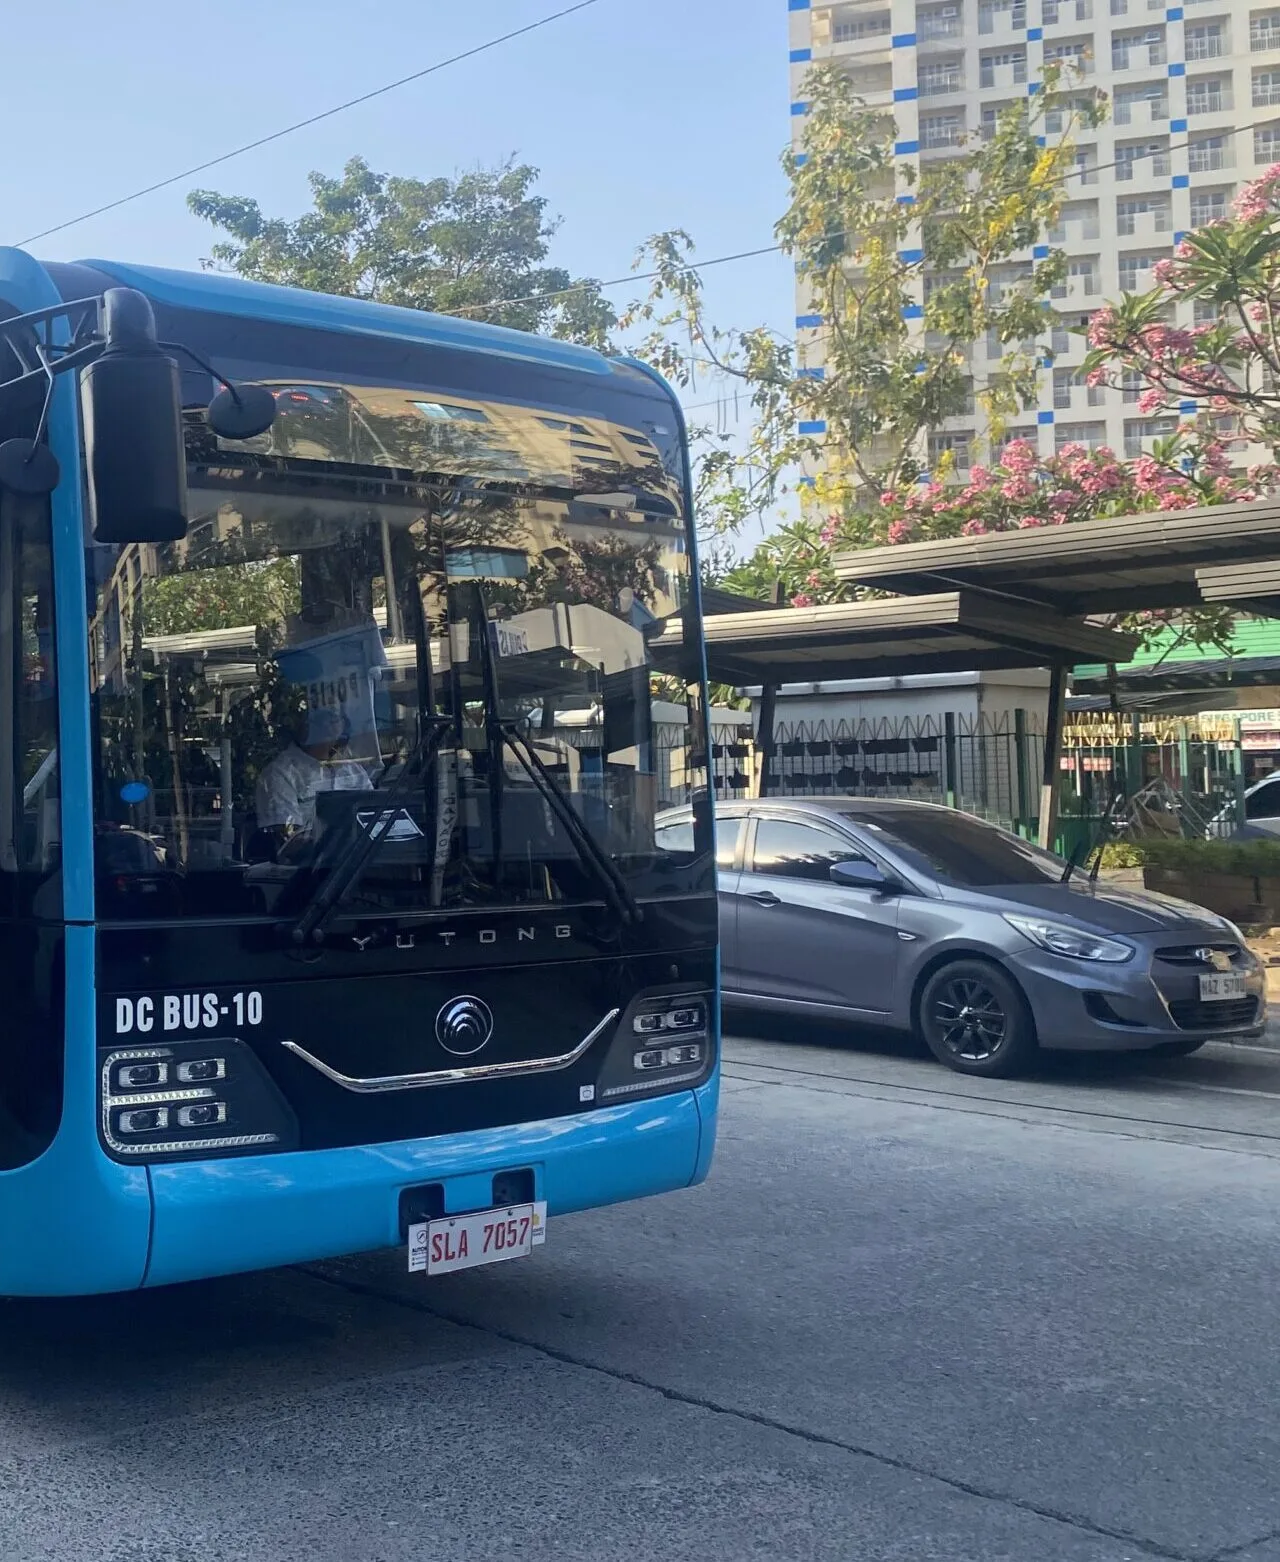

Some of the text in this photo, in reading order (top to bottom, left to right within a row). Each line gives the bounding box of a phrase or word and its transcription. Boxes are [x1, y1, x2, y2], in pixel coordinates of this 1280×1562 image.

[352, 924, 571, 950] YUTONG
[116, 991, 263, 1033] DC BUS-10
[431, 1229, 468, 1263] SLA
[482, 1217, 530, 1254] 7057
